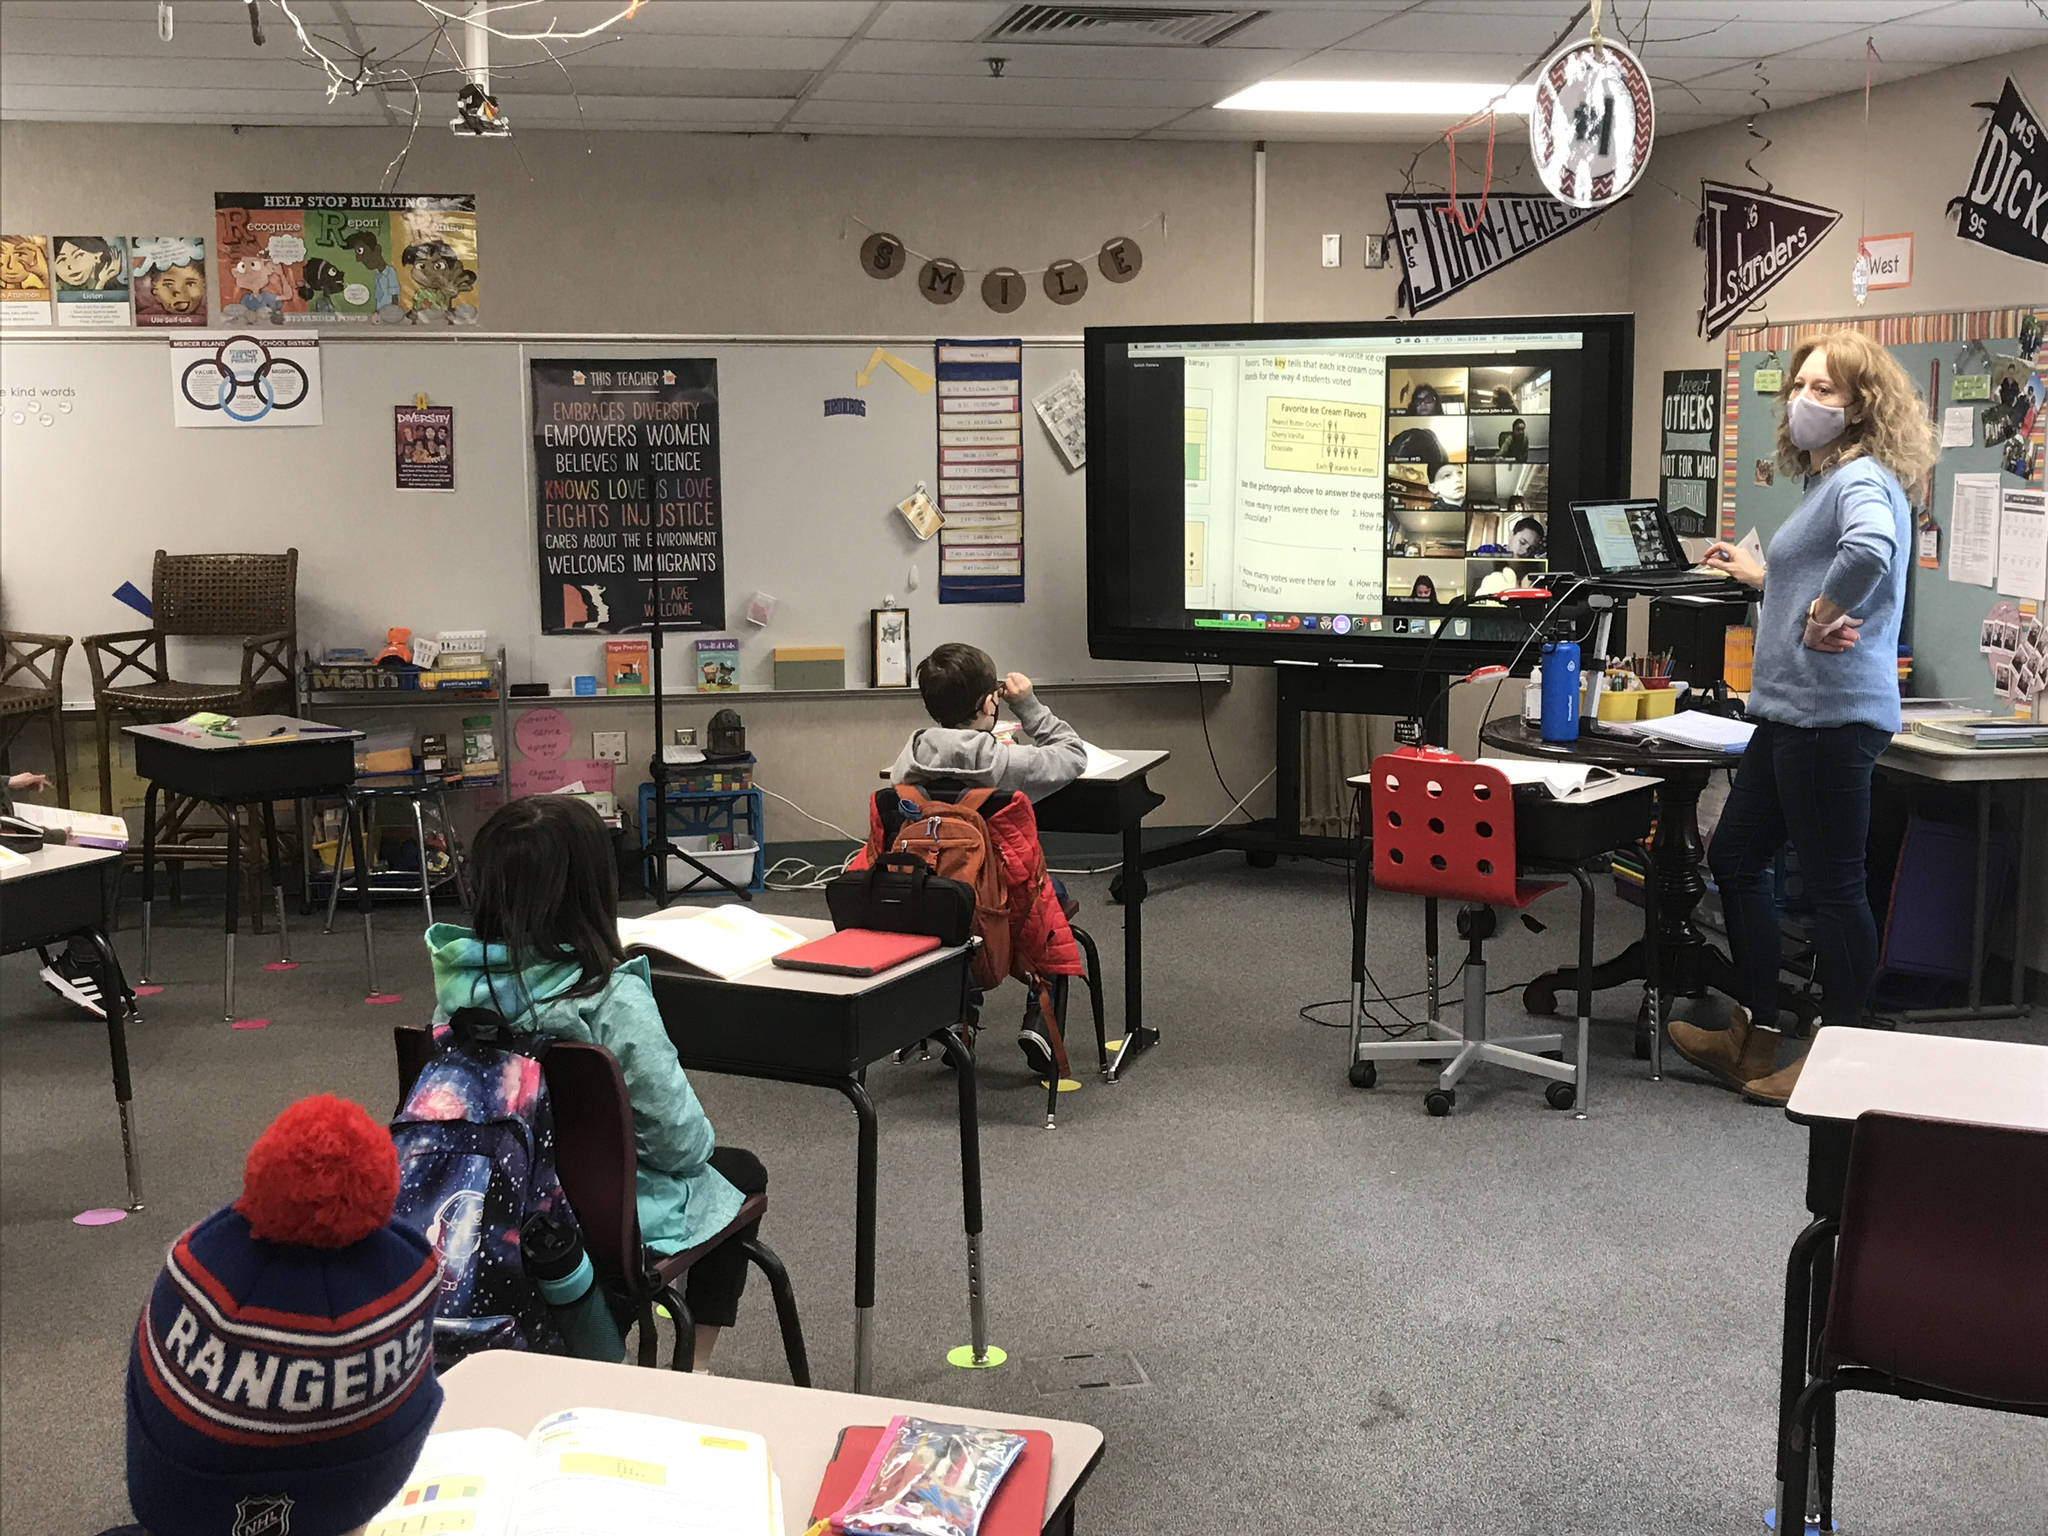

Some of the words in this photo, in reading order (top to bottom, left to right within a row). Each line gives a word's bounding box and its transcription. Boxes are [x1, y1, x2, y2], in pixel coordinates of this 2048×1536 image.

[2009, 111, 2038, 154] MS.
[264, 196, 303, 208] HELP
[308, 196, 347, 208] STOP
[351, 196, 429, 208] BULLYING
[316, 210, 381, 248] Report
[1968, 207, 1987, 239] '95
[1708, 201, 1808, 318] Islanders
[1869, 254, 1900, 276] West
[1262, 358, 1273, 367] The
[1274, 357, 1286, 369] key
[1303, 360, 1318, 369] that
[1319, 361, 1335, 370] each
[1336, 363, 1346, 372] ice
[1347, 366, 1367, 374] cream
[1368, 368, 1384, 376] cone
[590, 371, 612, 386] THIS
[616, 371, 659, 386] TEACHER
[1269, 371, 1279, 380] the
[1281, 374, 1294, 383] way
[1302, 374, 1331, 384] students
[1678, 372, 1711, 397] Accept
[10, 387, 37, 397] kind
[41, 387, 77, 397] words
[397, 412, 451, 424] DIVERSITY
[553, 402, 625, 421] EMBRACES
[633, 402, 700, 421] DIVERSITY
[1281, 403, 1309, 414] Favorite
[1310, 405, 1319, 415] Ice
[1321, 406, 1342, 416] Cream
[1343, 408, 1367, 419] Flavors
[1665, 394, 1715, 430] OTHERS
[545, 424, 637, 447] EMPOWERS
[647, 423, 711, 446] WOMEN
[556, 453, 618, 473] BELIEVES
[626, 453, 639, 471] IN
[1661, 455, 1676, 477] NOT
[1678, 455, 1693, 477] FOR
[1696, 455, 1717, 479] WHO
[545, 480, 600, 500] KNOWS
[609, 479, 646, 499] LOVE
[655, 478, 668, 498] IS
[677, 477, 714, 499] LOVE
[1258, 481, 1291, 494] pictograph
[1293, 485, 1314, 496] above
[1315, 488, 1324, 496] to
[1325, 489, 1348, 498] answer
[1350, 490, 1361, 499] the
[546, 503, 609, 528] FIGHTS
[1244, 512, 1272, 524] hocolate?
[1274, 504, 1291, 513] votes
[1292, 506, 1309, 514] were
[1310, 506, 1328, 516] there
[1330, 507, 1340, 516] for
[1359, 510, 1374, 518] How
[1359, 523, 1374, 532] their
[545, 533, 578, 549] CARES
[583, 532, 617, 548] ABOUT
[623, 532, 641, 547] THE
[548, 555, 626, 574] WELCOMES
[1271, 574, 1288, 583] votes
[1307, 577, 1325, 586] there
[1327, 577, 1336, 586] for
[1356, 579, 1371, 588] How
[647, 587, 666, 601] AL
[671, 586, 689, 600] ARE
[1355, 592, 1365, 600] for
[644, 603, 694, 617] WLCOME
[608, 643, 621, 651] Yoga
[165, 1303, 427, 1413] RANGERS
[244, 1511, 279, 1536] NHL
